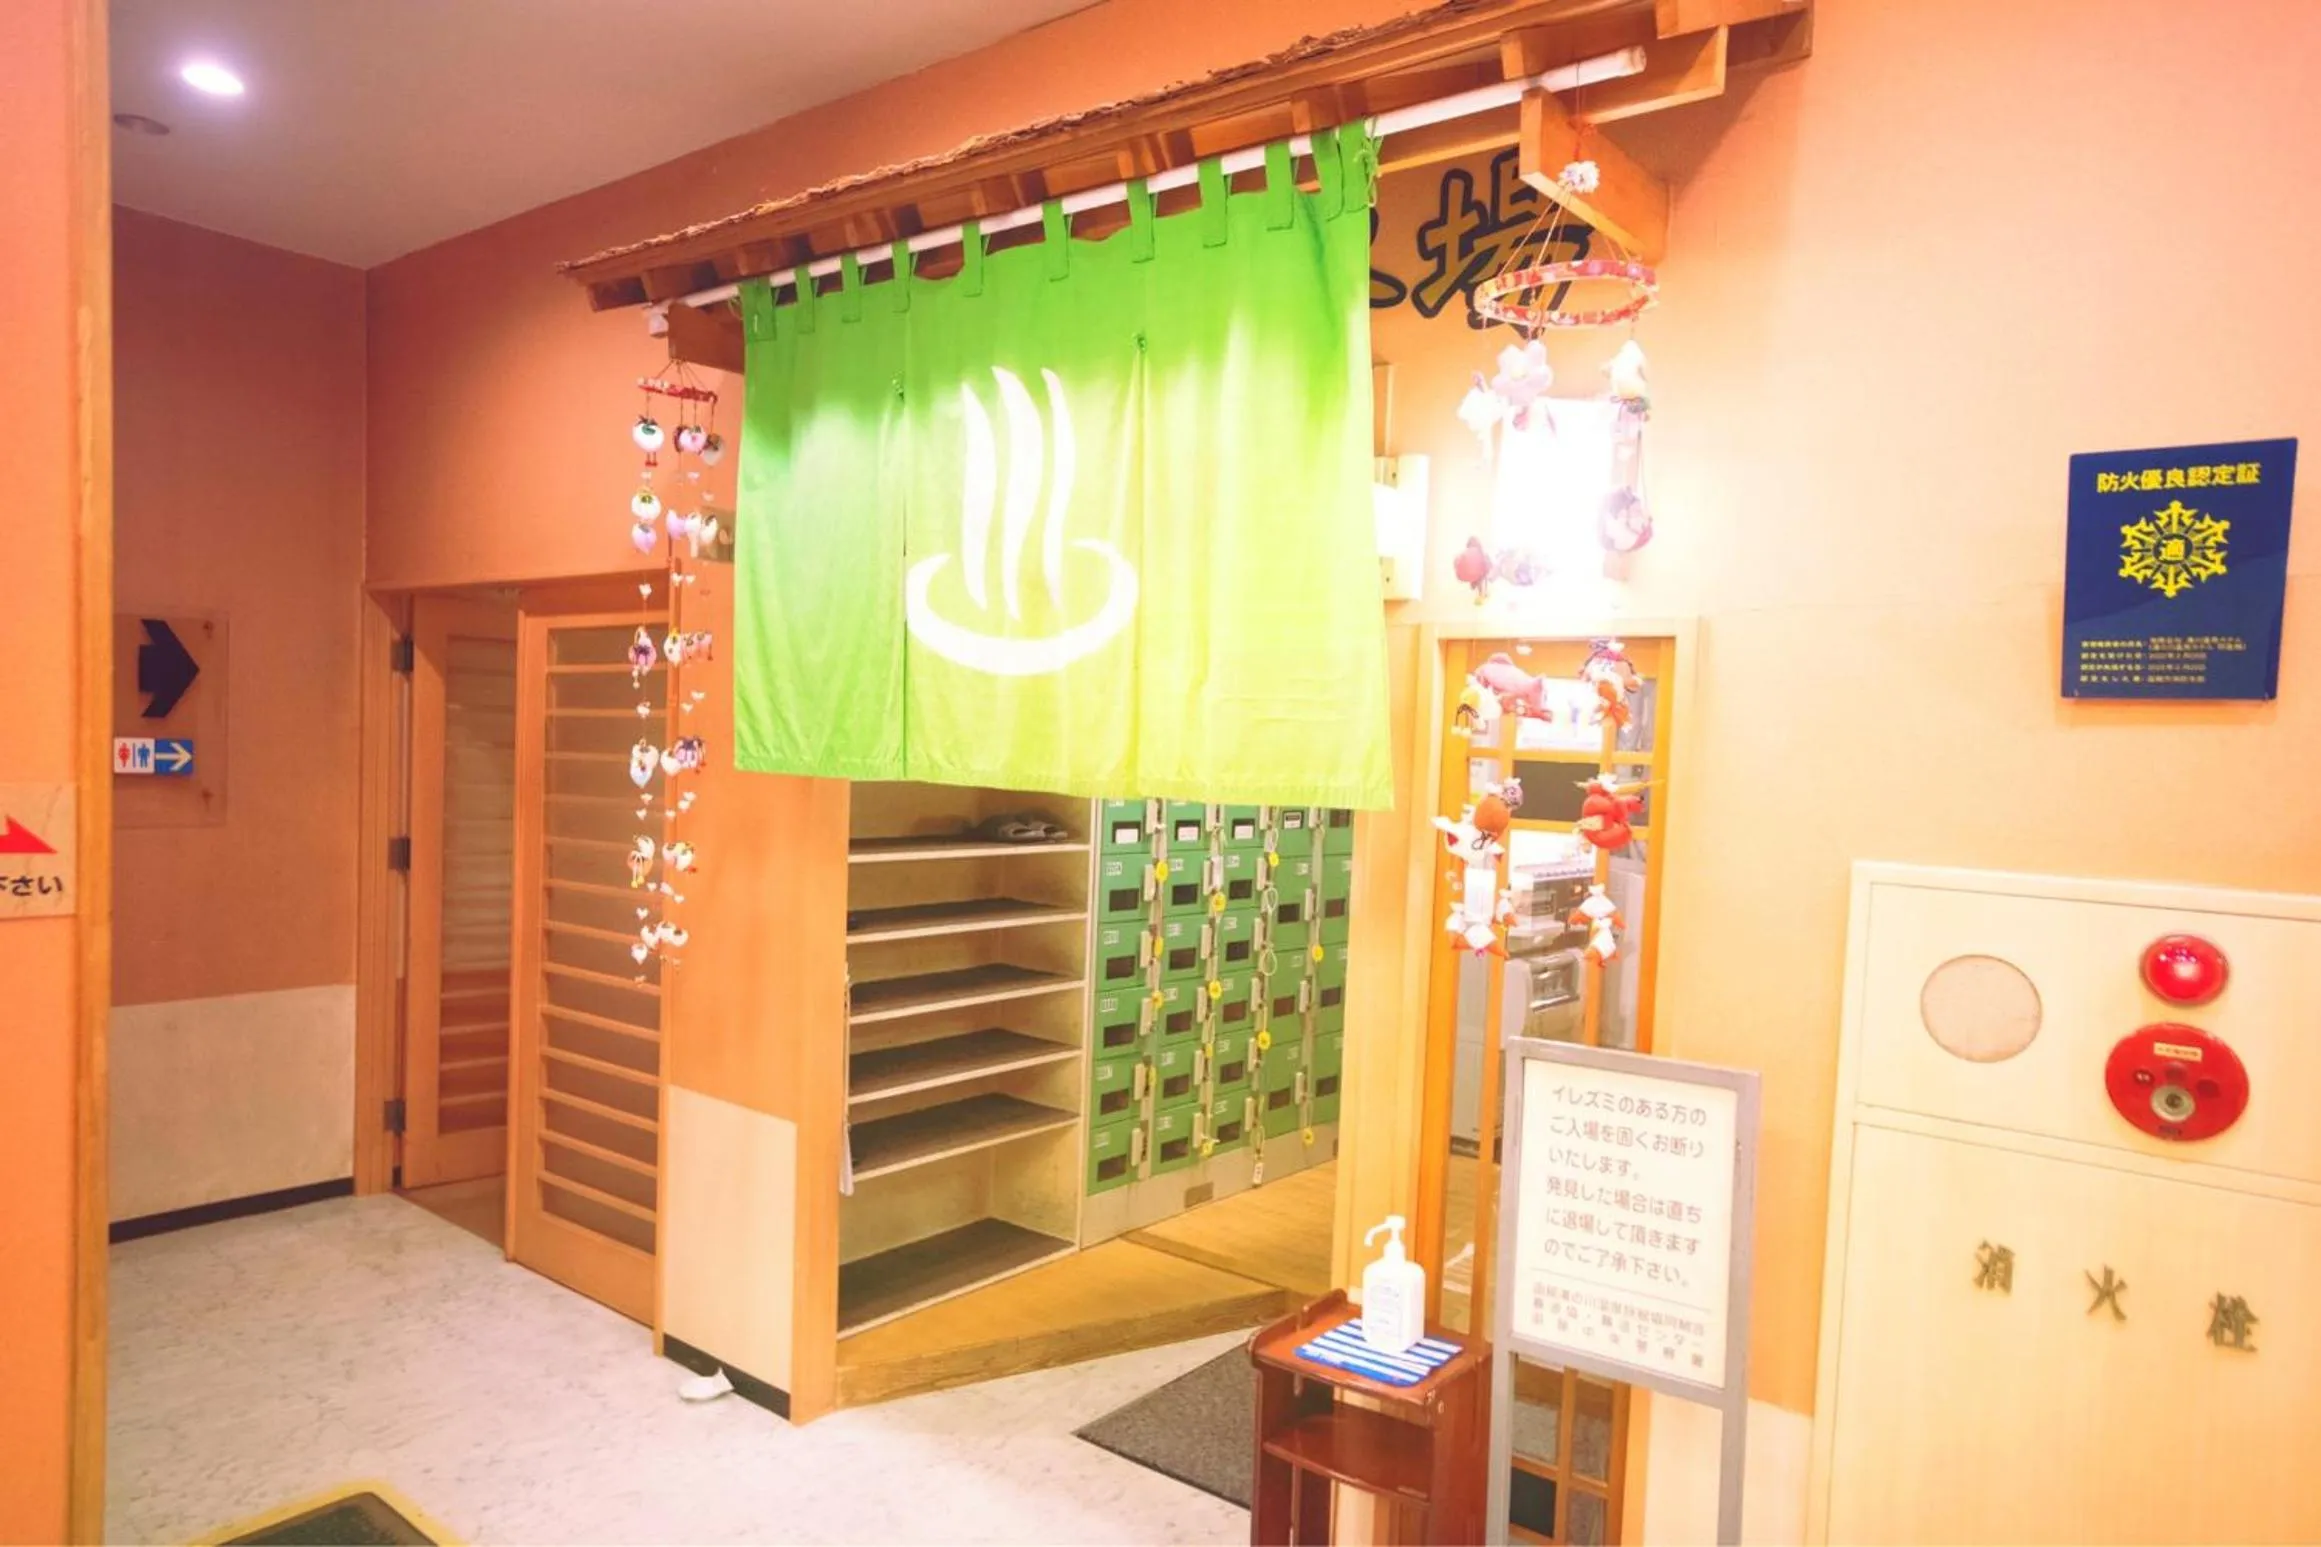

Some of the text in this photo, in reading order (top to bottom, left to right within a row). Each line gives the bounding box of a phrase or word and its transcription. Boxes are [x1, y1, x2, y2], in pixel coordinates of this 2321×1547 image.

[2096, 461, 2262, 493] 防火優良認定証
[1552, 1085, 1707, 1127] イレズミのある方の
[1550, 1115, 1705, 1159] ご入場を固くお断り
[1548, 1146, 1640, 1181] いたします。
[1546, 1175, 1702, 1225] 発見した場合は直ち
[1545, 1206, 1701, 1256] に退場して頂きます
[1543, 1237, 1689, 1288] のでご了承下さい。
[1973, 1239, 2260, 1353] 消火栓
